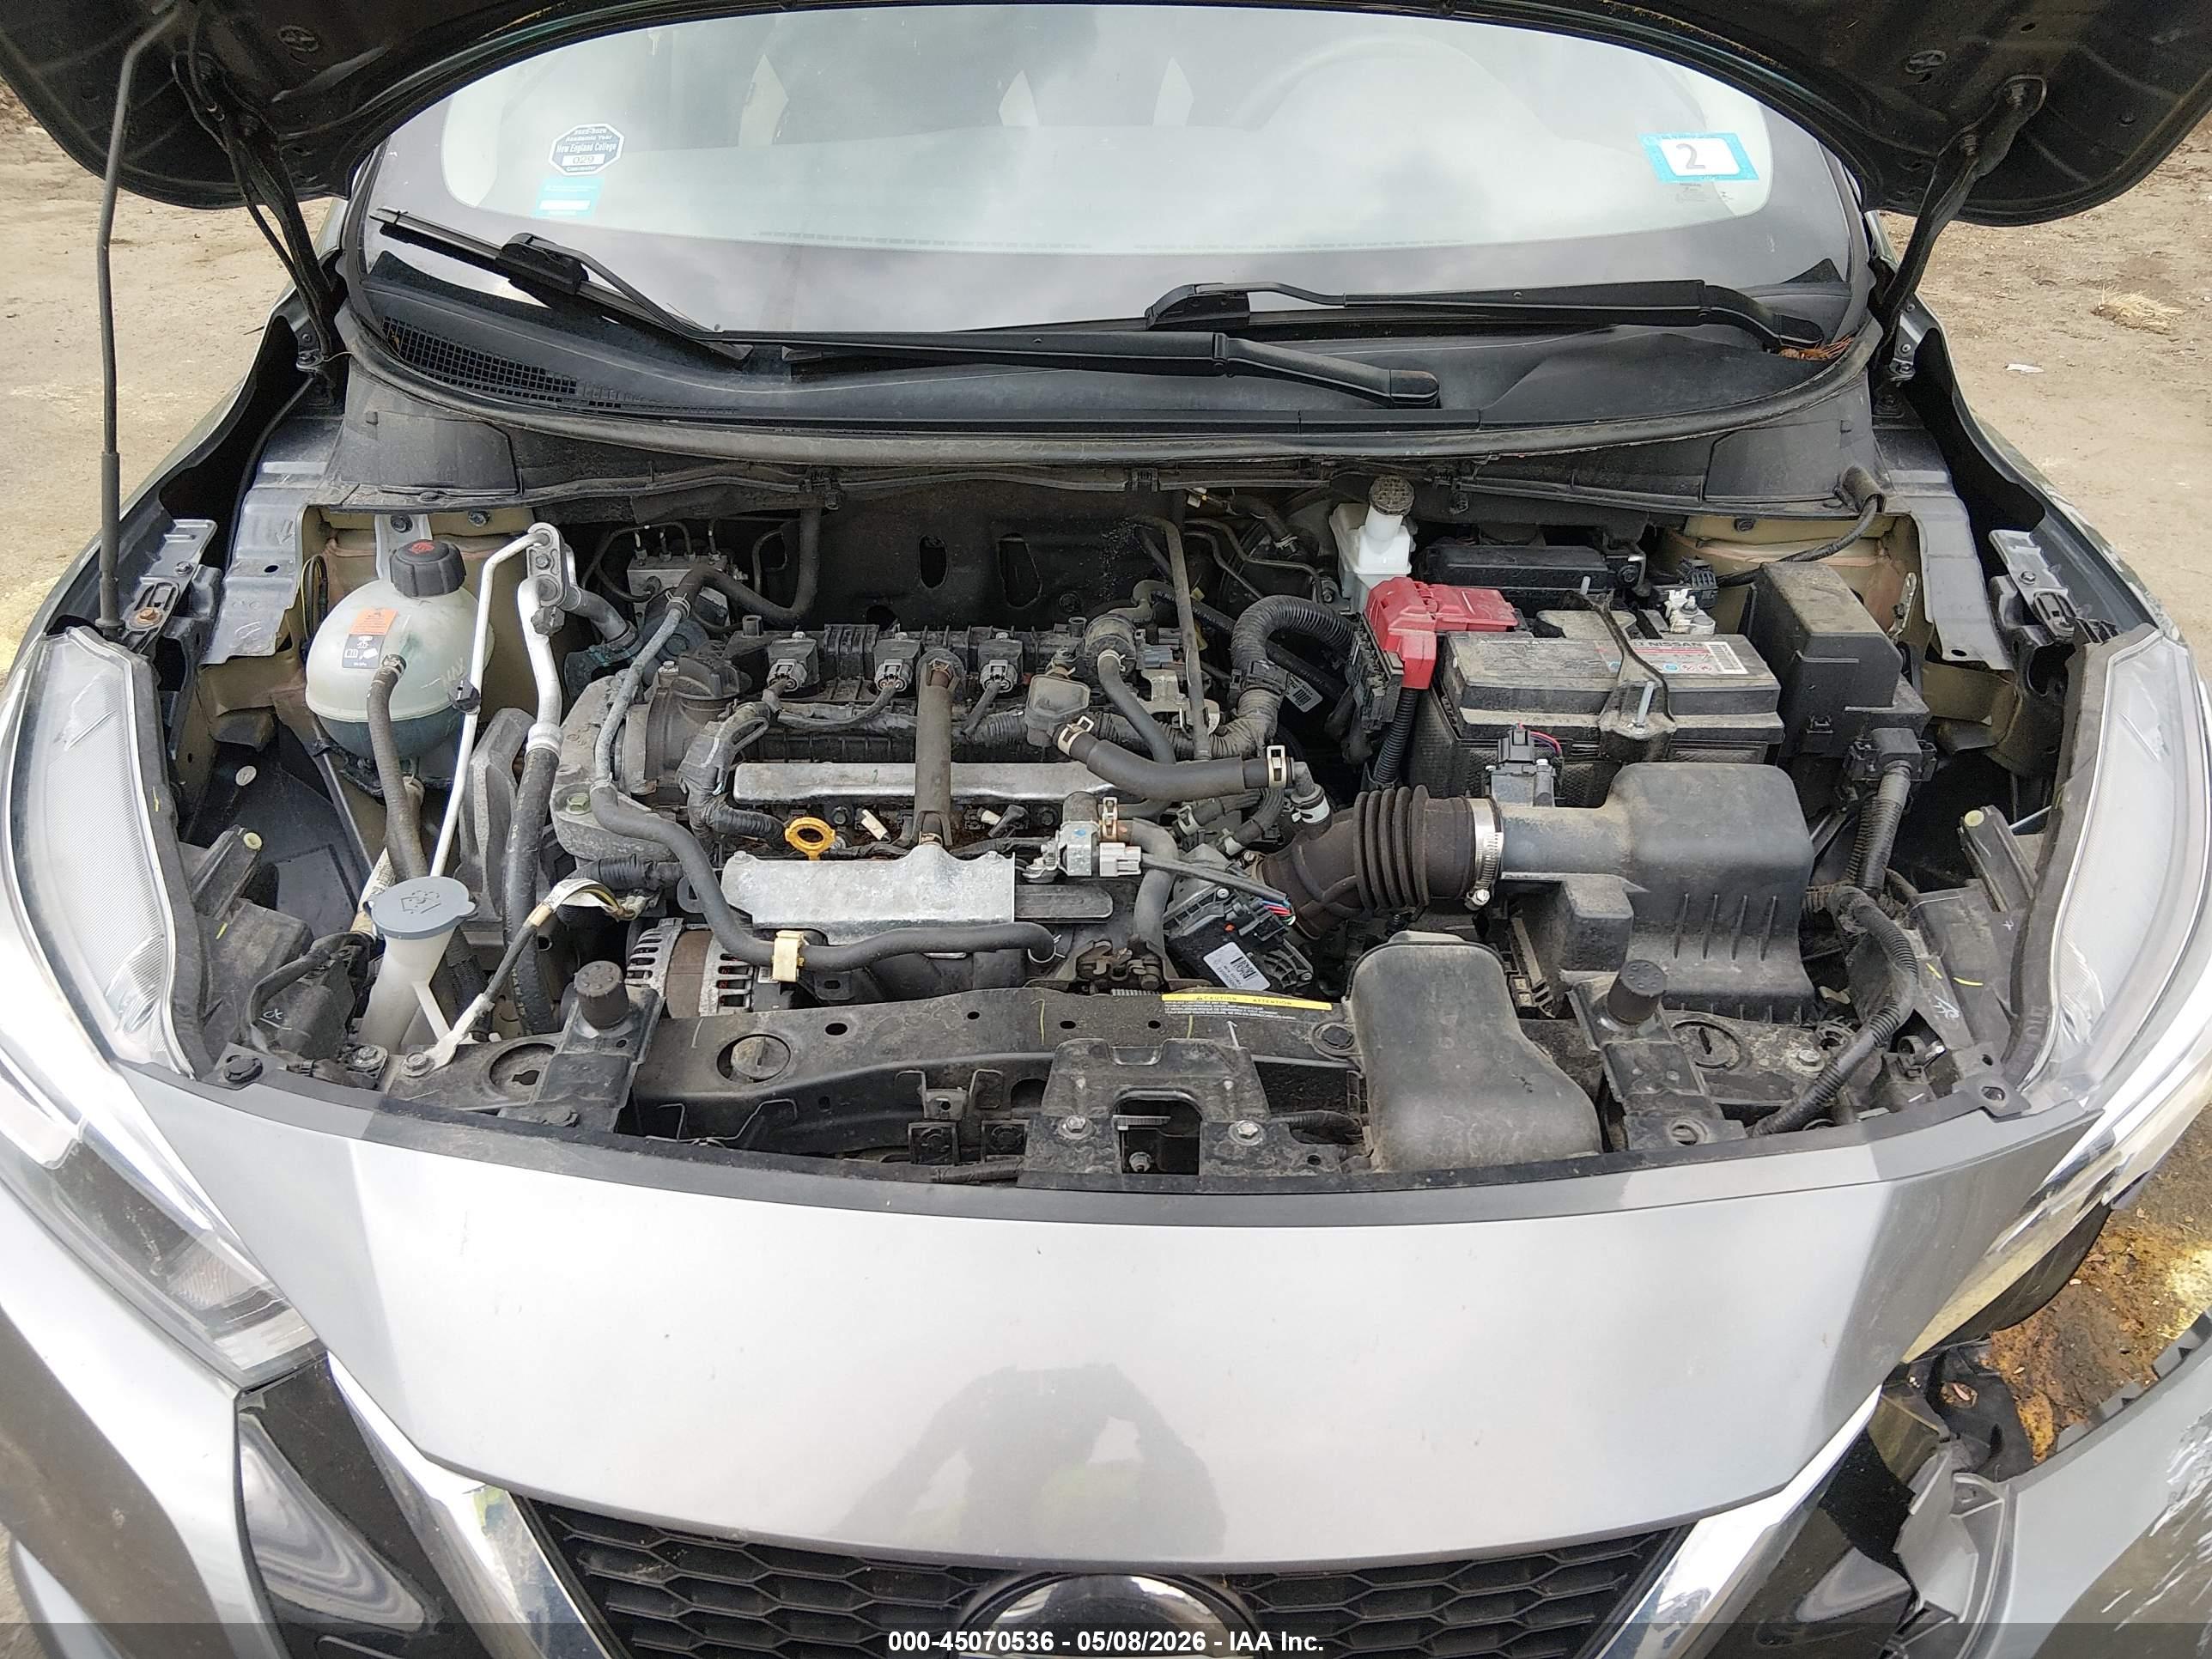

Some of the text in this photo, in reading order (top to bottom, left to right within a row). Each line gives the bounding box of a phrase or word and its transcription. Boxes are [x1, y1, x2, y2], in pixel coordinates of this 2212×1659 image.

[556, 142, 617, 154] New England College
[1675, 143, 1706, 169] 2
